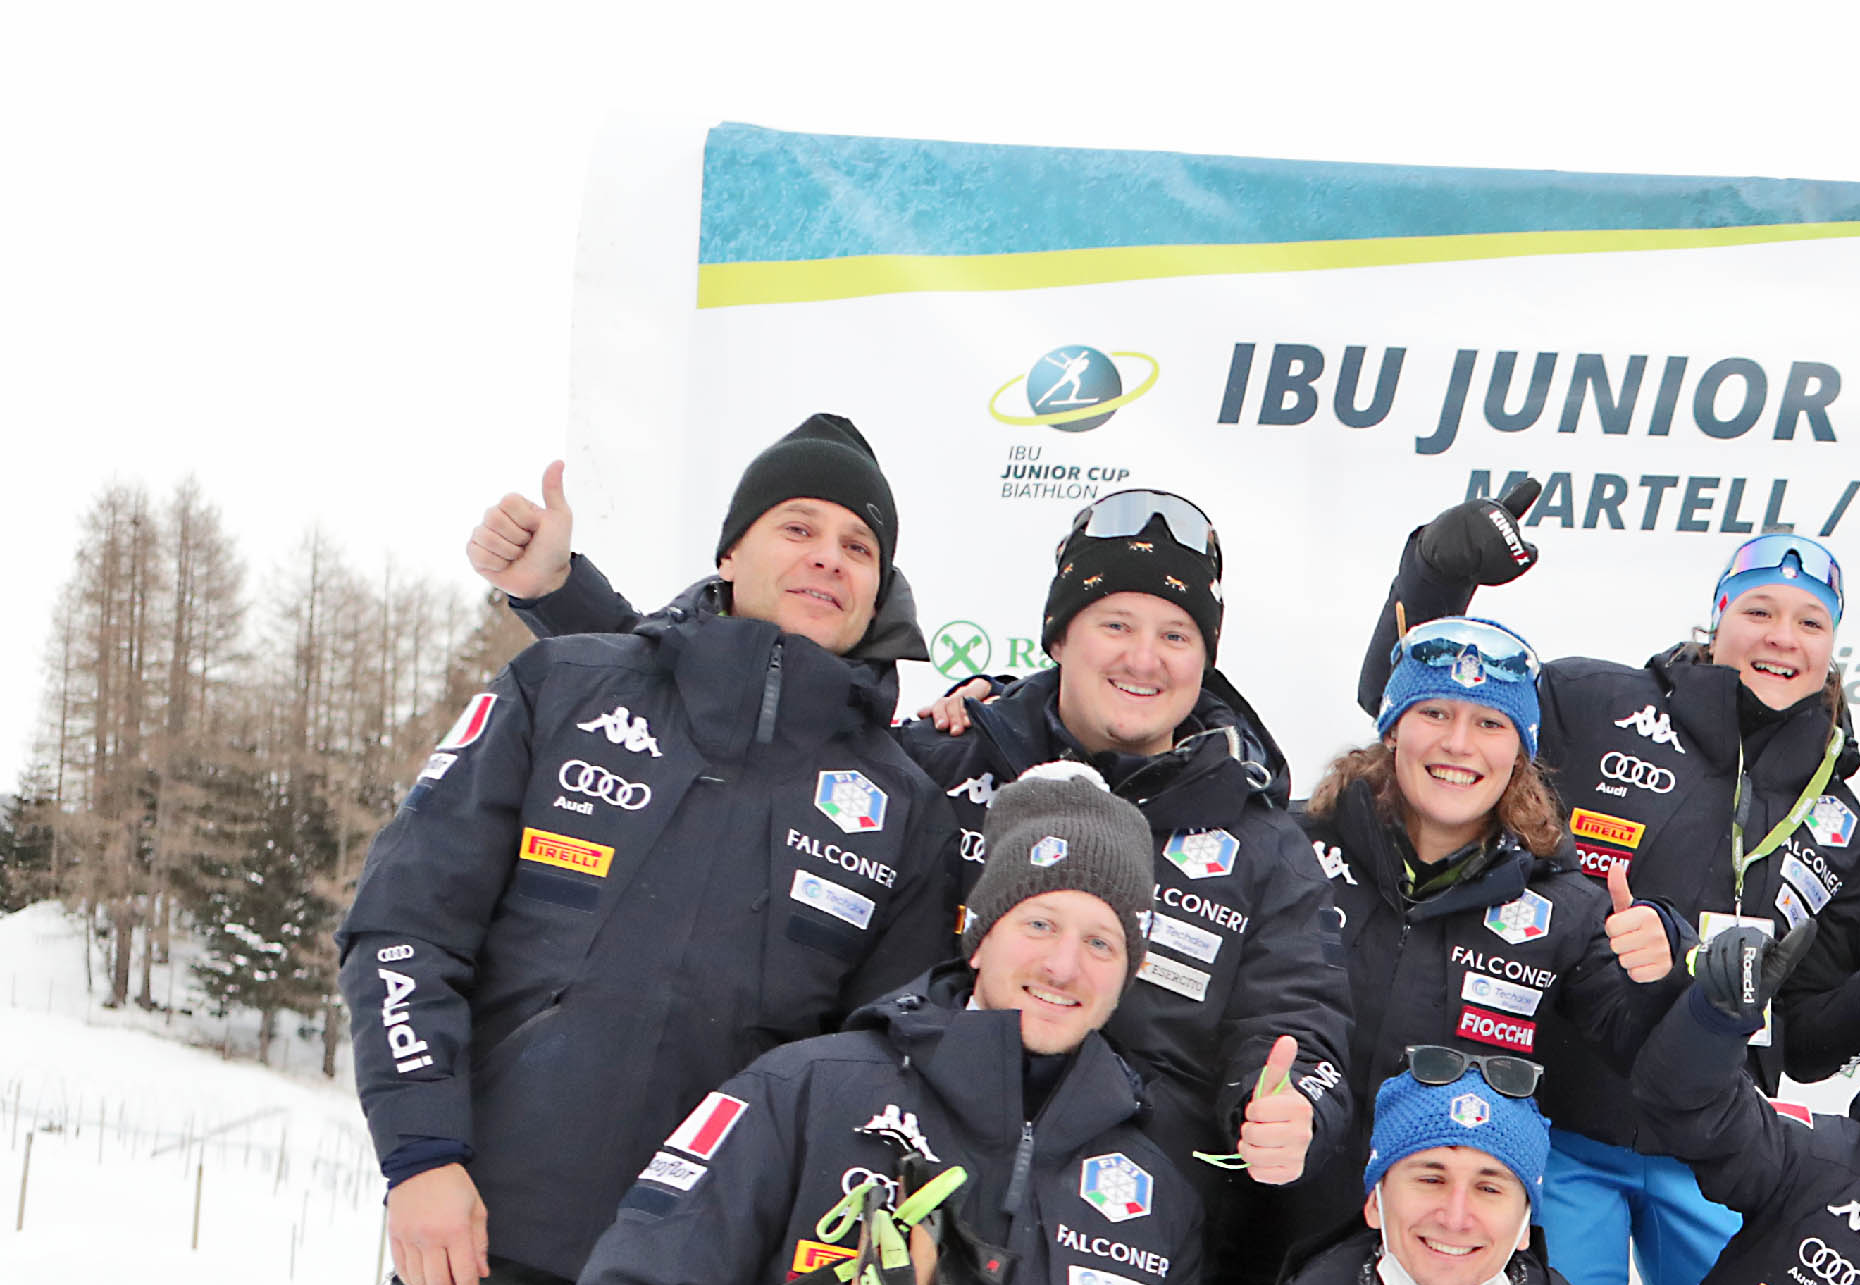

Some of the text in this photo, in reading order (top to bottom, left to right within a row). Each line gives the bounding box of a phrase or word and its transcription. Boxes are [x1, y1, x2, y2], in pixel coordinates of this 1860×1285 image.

[1217, 342, 1406, 429] IBU
[1414, 347, 1842, 456] JUNIOR
[1008, 445, 1042, 461] IBU
[1000, 464, 1131, 483] JUNIOR CUP
[1001, 482, 1099, 499] BIATHLON
[553, 796, 594, 816] Audi
[1595, 782, 1628, 798] Audi
[1576, 815, 1636, 842] PIRELLI
[528, 835, 603, 869] PIRELLI
[786, 827, 898, 889] FALCONER
[1153, 883, 1249, 935] LCONERI
[377, 966, 434, 1075] Audi
[1460, 1012, 1534, 1046] FIOCCHI
[1056, 1223, 1171, 1278] FALCONER
